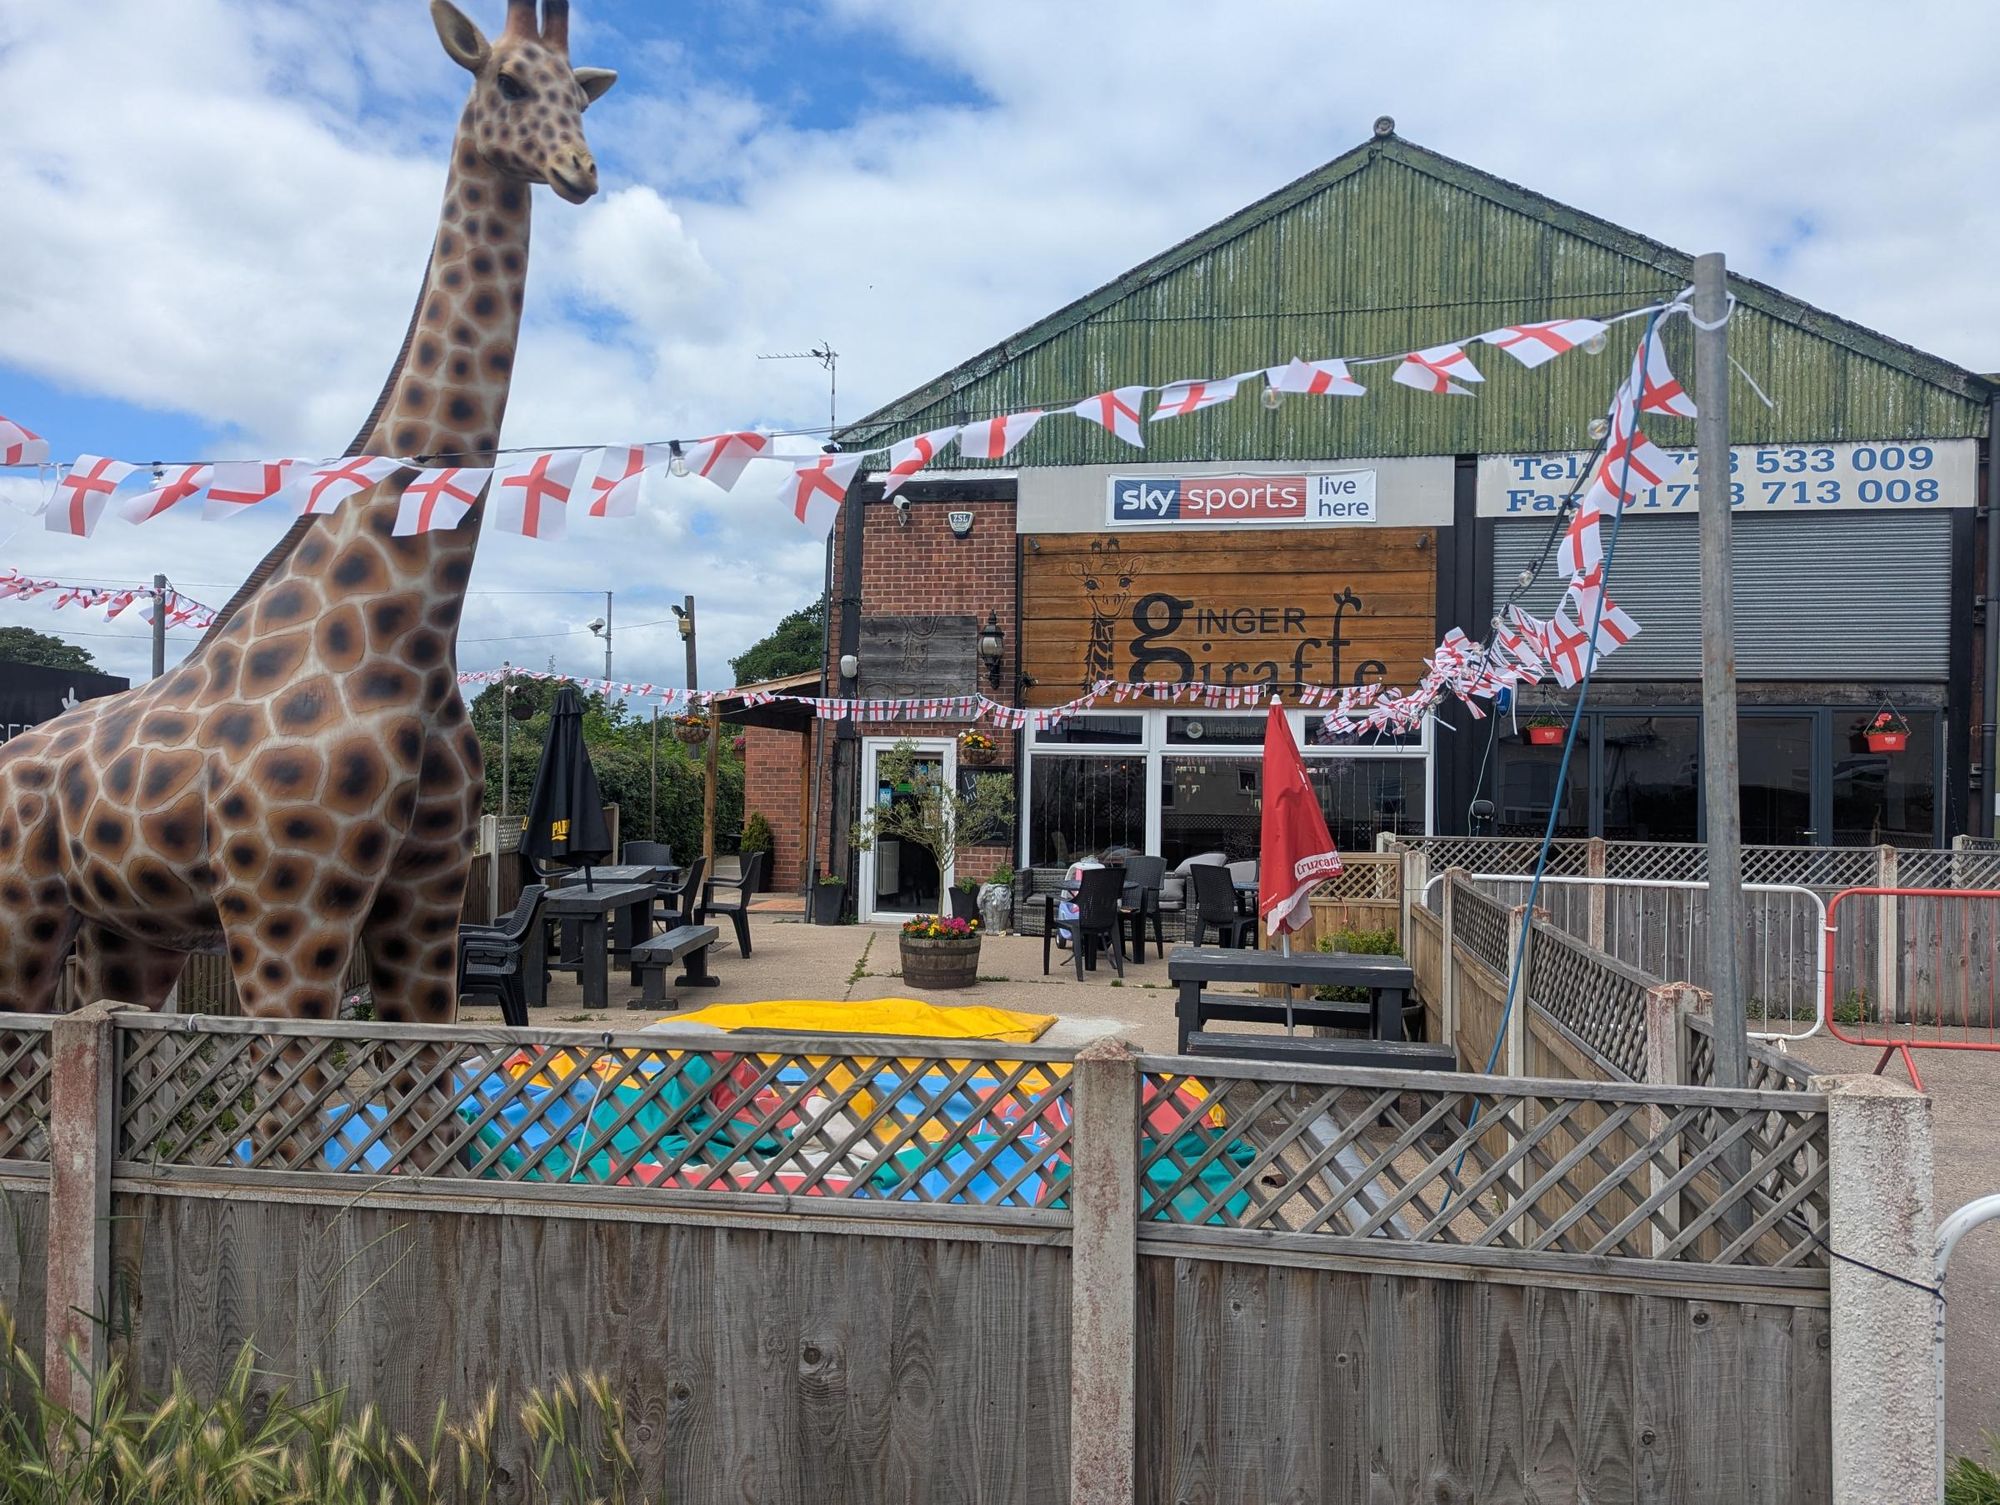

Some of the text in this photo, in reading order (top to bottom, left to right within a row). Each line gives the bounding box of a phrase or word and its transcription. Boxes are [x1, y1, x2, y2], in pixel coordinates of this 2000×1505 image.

[1755, 448, 1835, 474] 533
[1851, 446, 1934, 472] 009
[1122, 483, 1298, 516] sky sports
[1318, 477, 1357, 496] live
[1762, 480, 1841, 505] 713
[1857, 478, 1939, 503] 008
[1318, 498, 1370, 517] here
